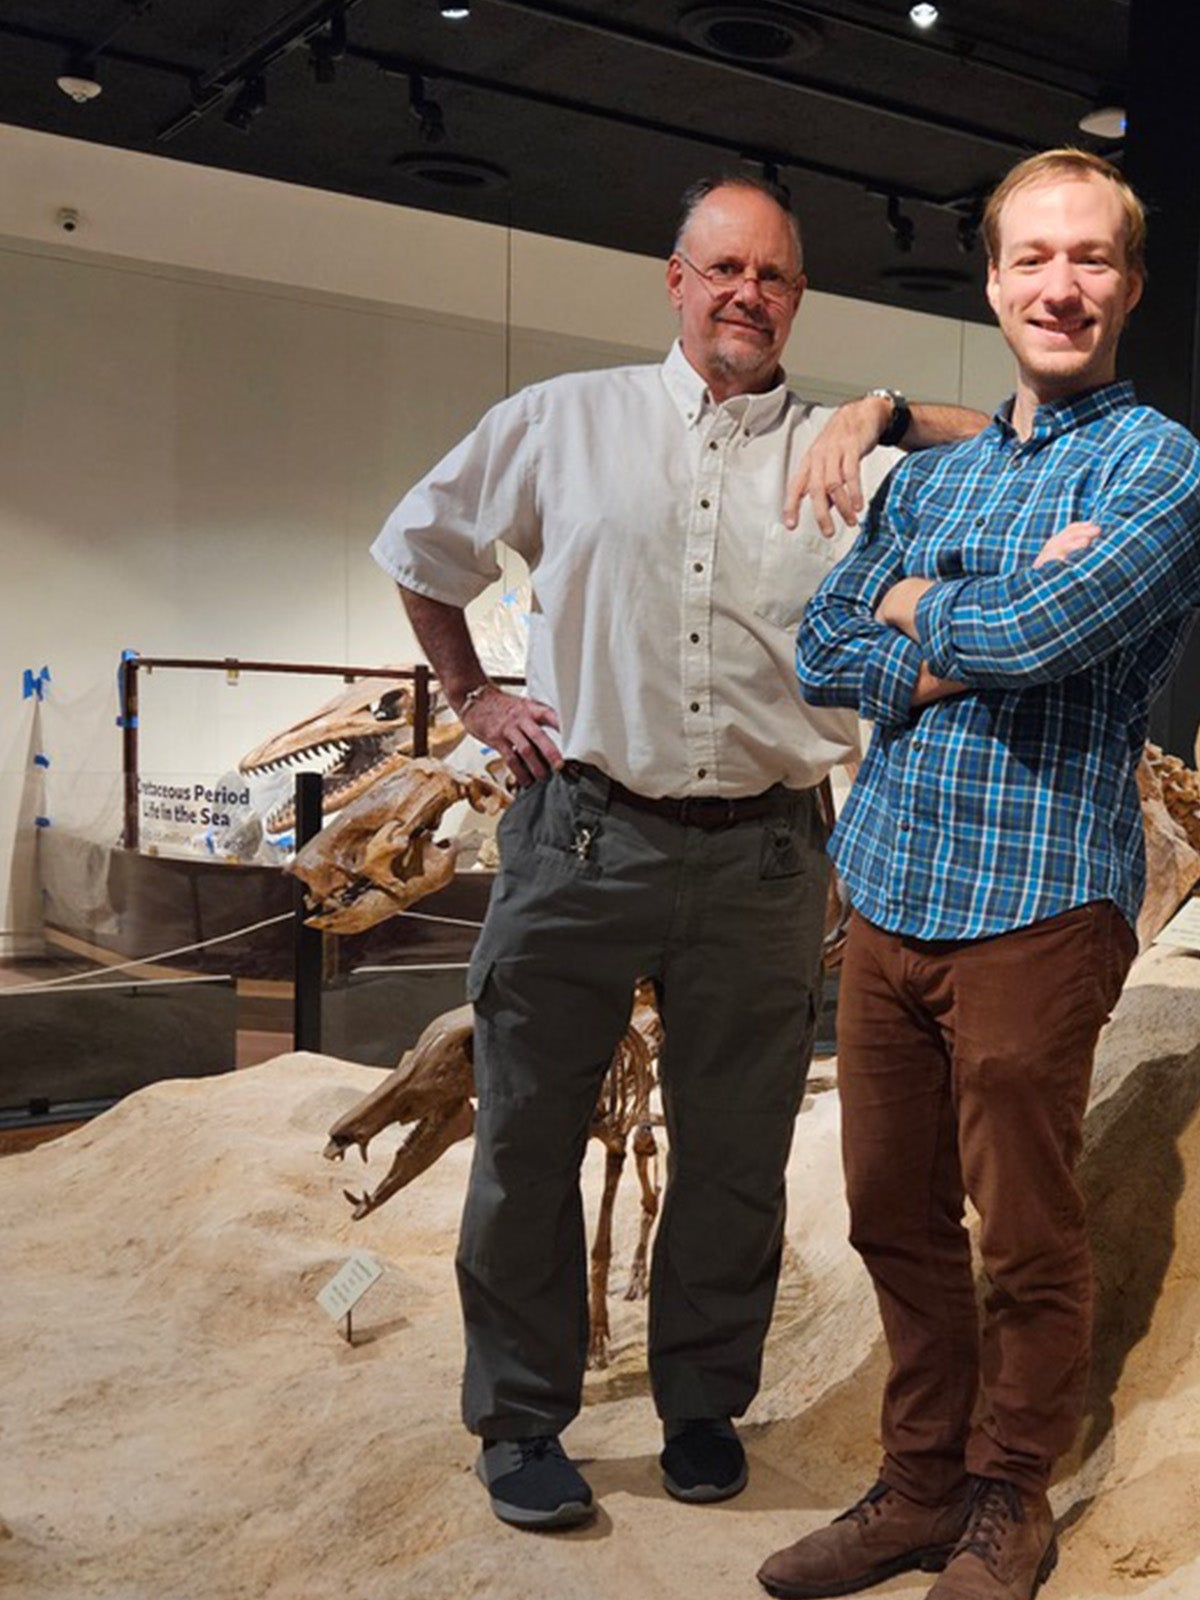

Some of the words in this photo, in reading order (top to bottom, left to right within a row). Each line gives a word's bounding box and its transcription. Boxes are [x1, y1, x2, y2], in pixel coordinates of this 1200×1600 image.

[139, 782, 191, 801] retaceous
[194, 785, 250, 805] Period
[174, 806, 197, 824] the
[200, 808, 231, 826] Sea
